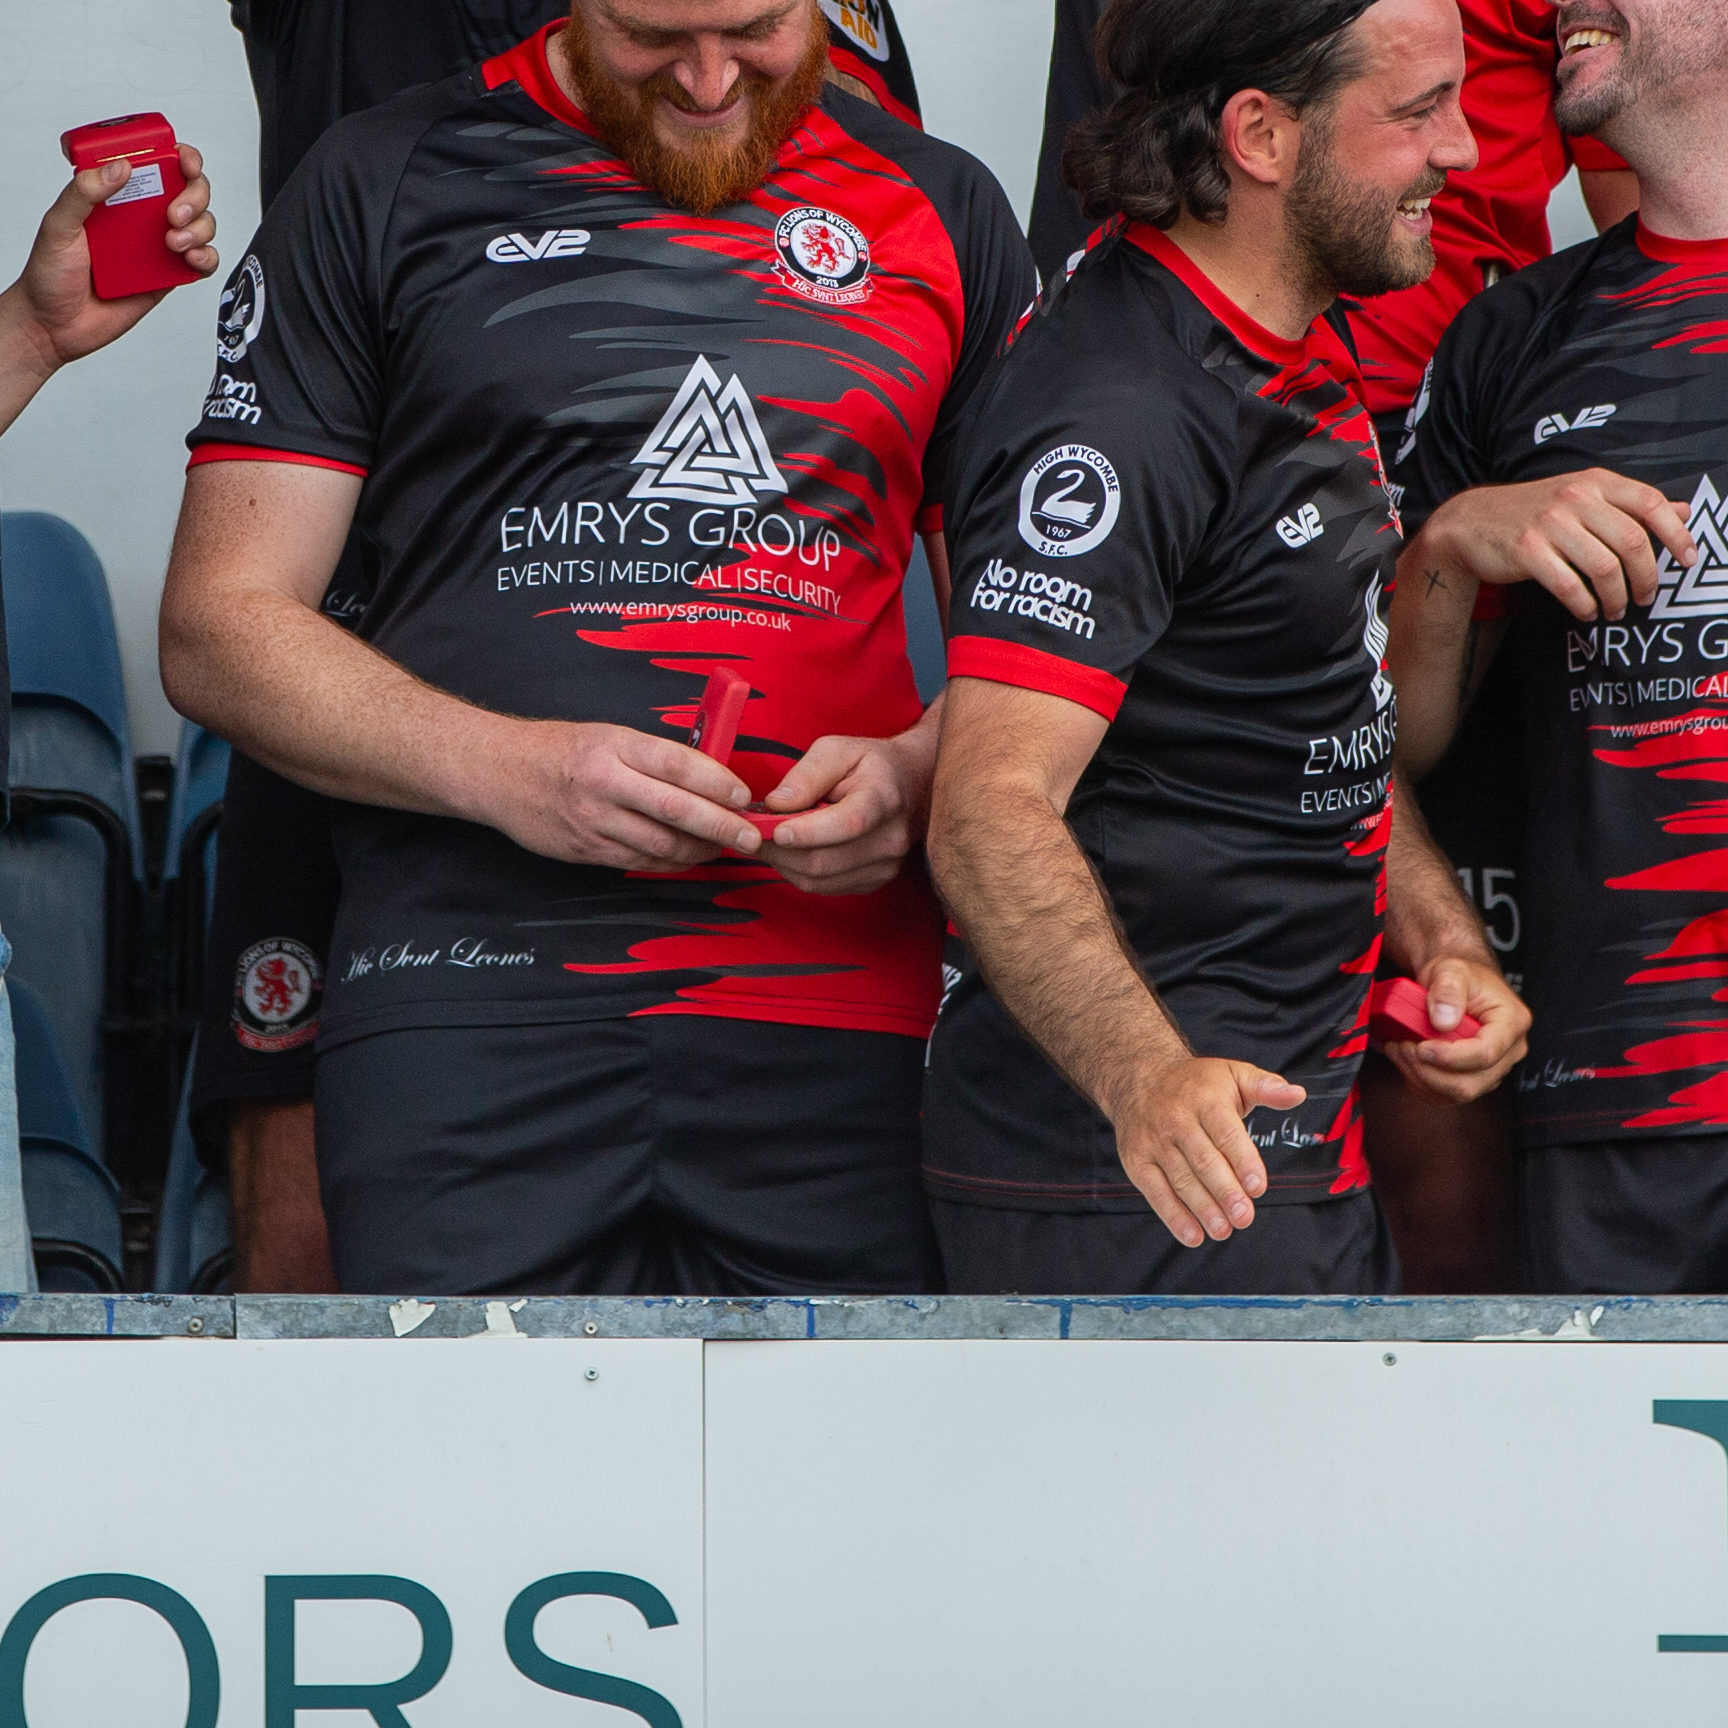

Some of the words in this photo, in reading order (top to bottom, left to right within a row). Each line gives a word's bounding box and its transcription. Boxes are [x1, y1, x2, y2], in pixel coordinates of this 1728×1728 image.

[840, 7, 877, 50] AID
[779, 225, 790, 238] FC
[783, 209, 809, 227] LIONS
[809, 209, 823, 219] OF
[826, 212, 867, 252] WYCOMBE
[816, 276, 839, 288] 2013
[1033, 446, 1063, 475] HIGH
[1068, 446, 1118, 493] WYCOMBE
[501, 502, 671, 553] EMRYS
[688, 508, 841, 571] GROUP
[1038, 541, 1068, 556] S.F.C.
[1046, 524, 1071, 538] 1967
[610, 560, 731, 589] MEDICAL
[744, 567, 842, 615] SECURITY
[979, 559, 1017, 588] No
[1019, 571, 1092, 611] room
[570, 599, 792, 632] www.emrysgroup.co.uk
[1008, 594, 1096, 639] racism
[1567, 623, 1684, 673] EMRYS
[1304, 711, 1391, 775] EMRYS
[445, 937, 535, 968] Leones
